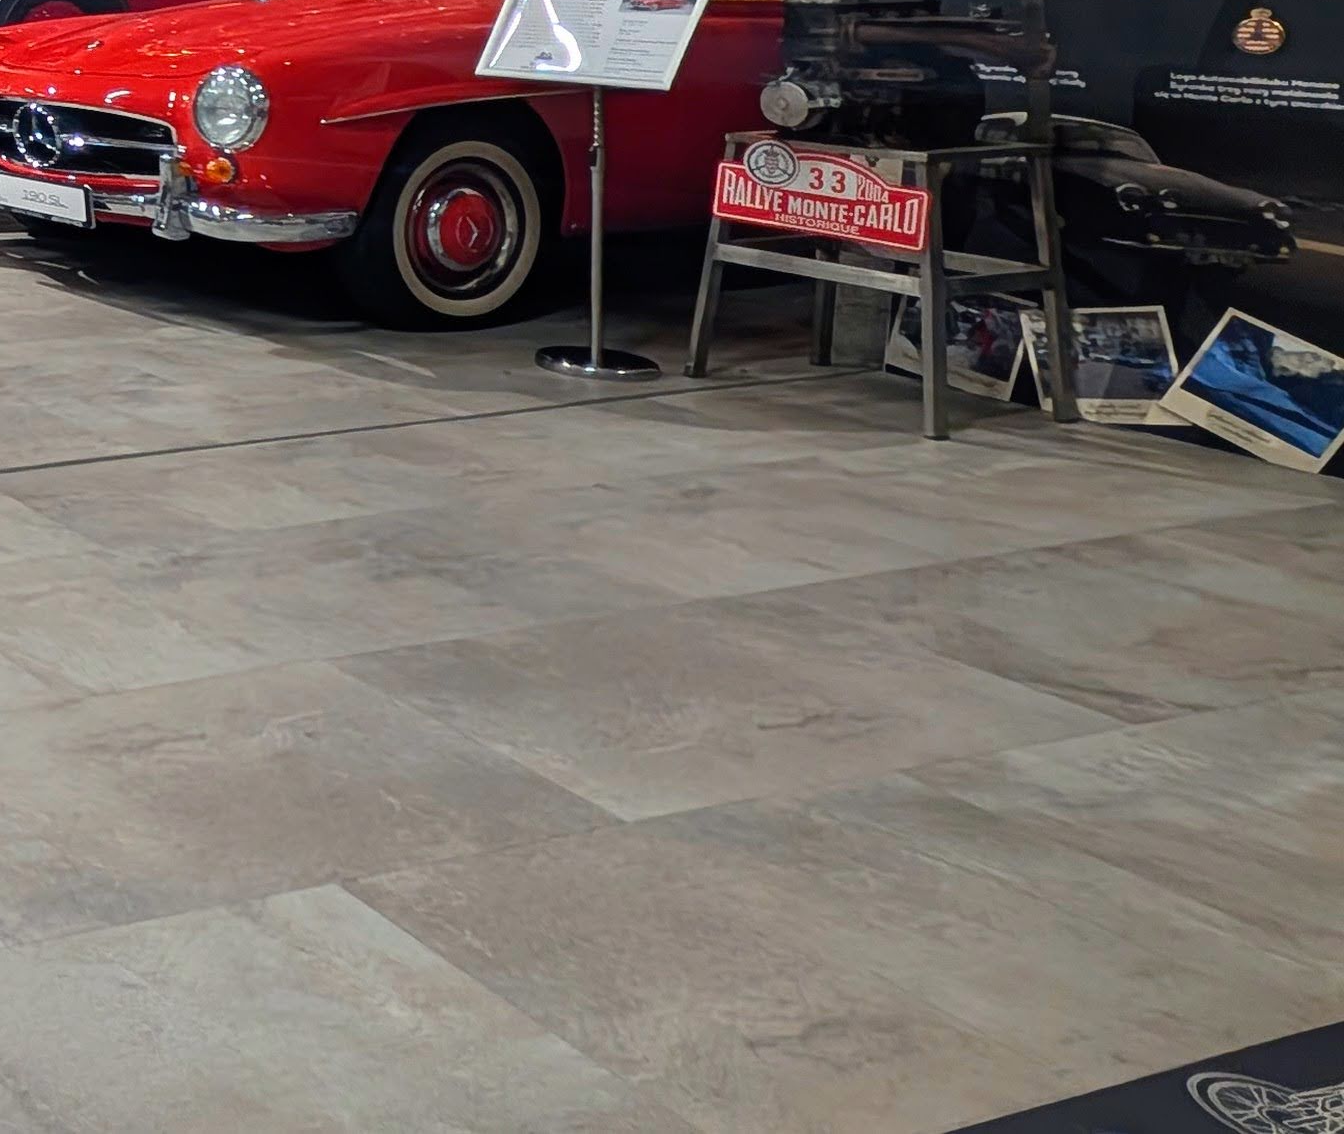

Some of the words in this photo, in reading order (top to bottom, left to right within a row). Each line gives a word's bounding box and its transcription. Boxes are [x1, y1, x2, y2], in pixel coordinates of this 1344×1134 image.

[722, 169, 783, 212] RALLYE
[787, 197, 919, 235] MONTE-CARLO
[808, 167, 846, 194] 33
[857, 174, 889, 203] 2004
[774, 212, 860, 235] HISTORIQUE
